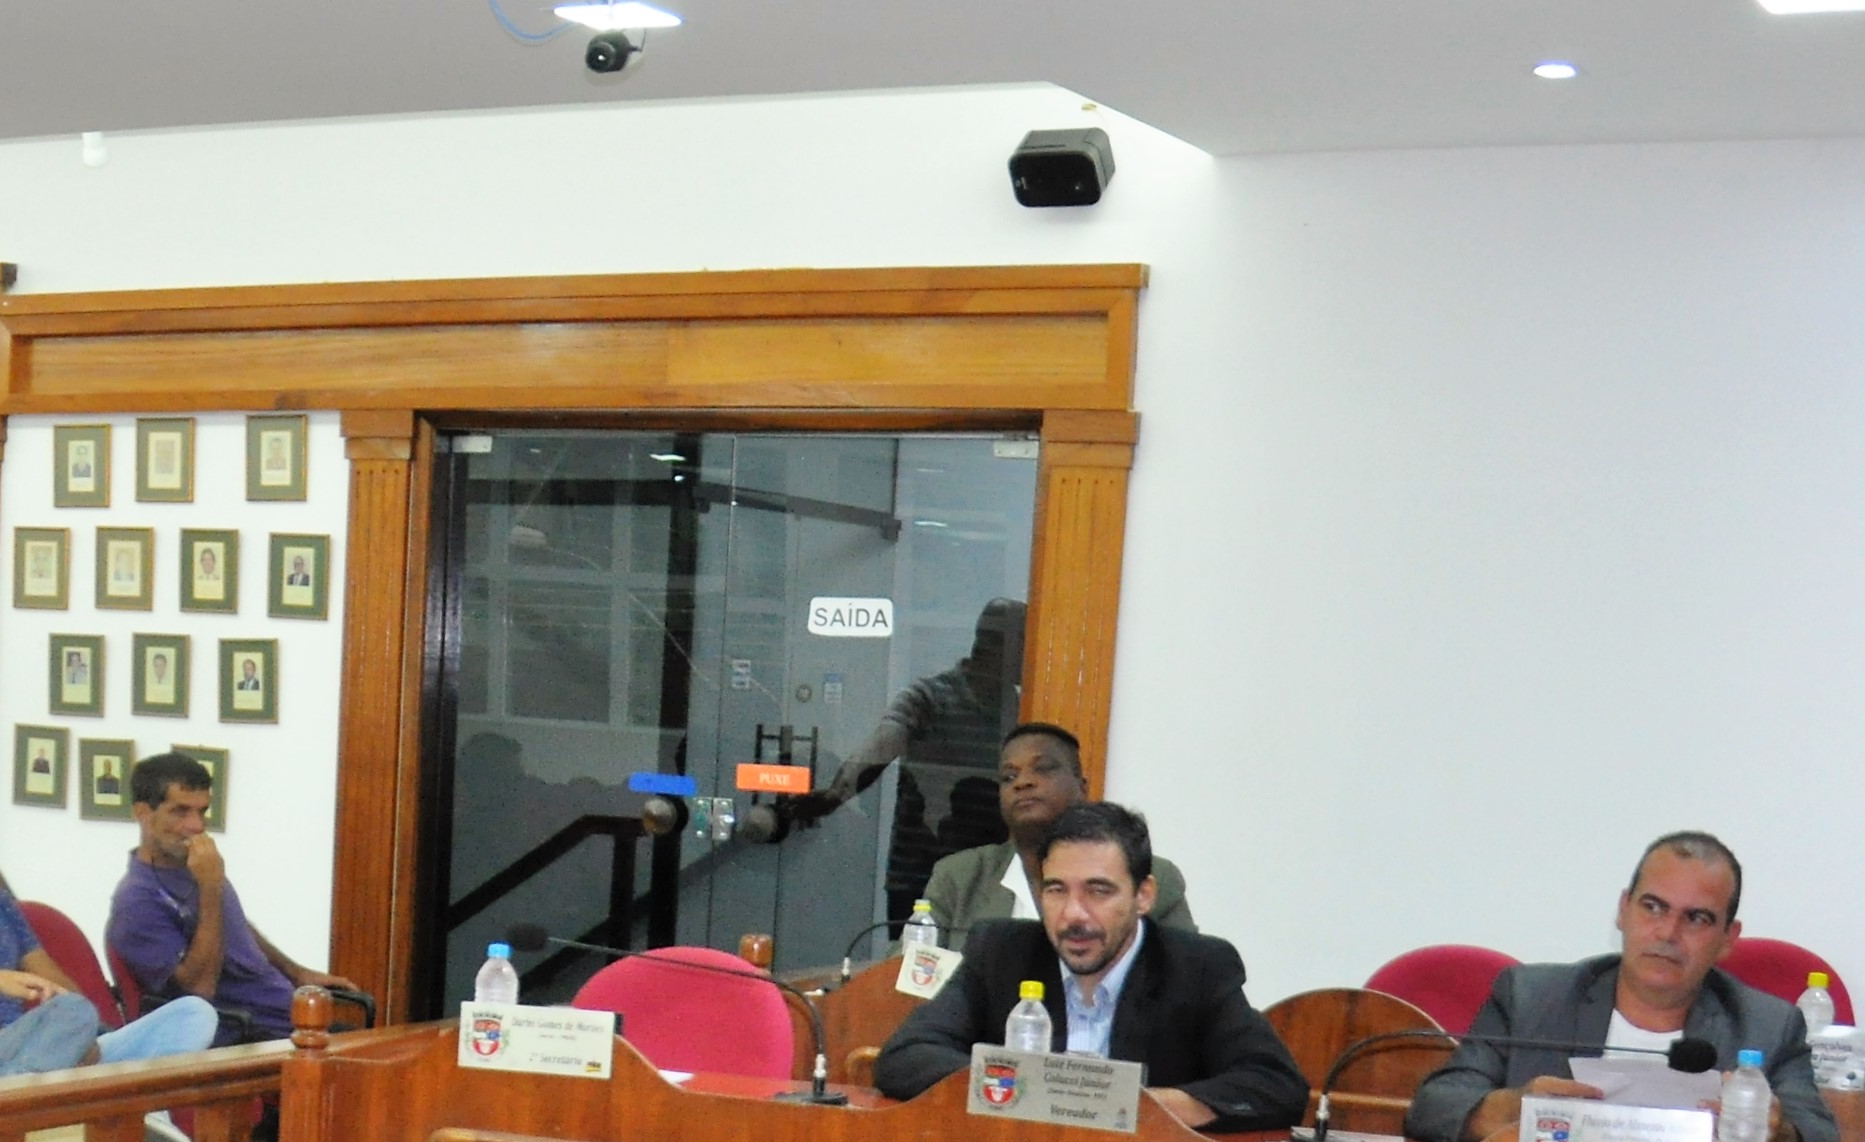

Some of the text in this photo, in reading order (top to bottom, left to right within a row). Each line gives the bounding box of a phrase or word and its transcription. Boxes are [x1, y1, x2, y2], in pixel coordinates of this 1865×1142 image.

[813, 602, 888, 628] SAÍDA
[759, 773, 791, 786] PUXE
[1050, 1104, 1098, 1120] Vereador
